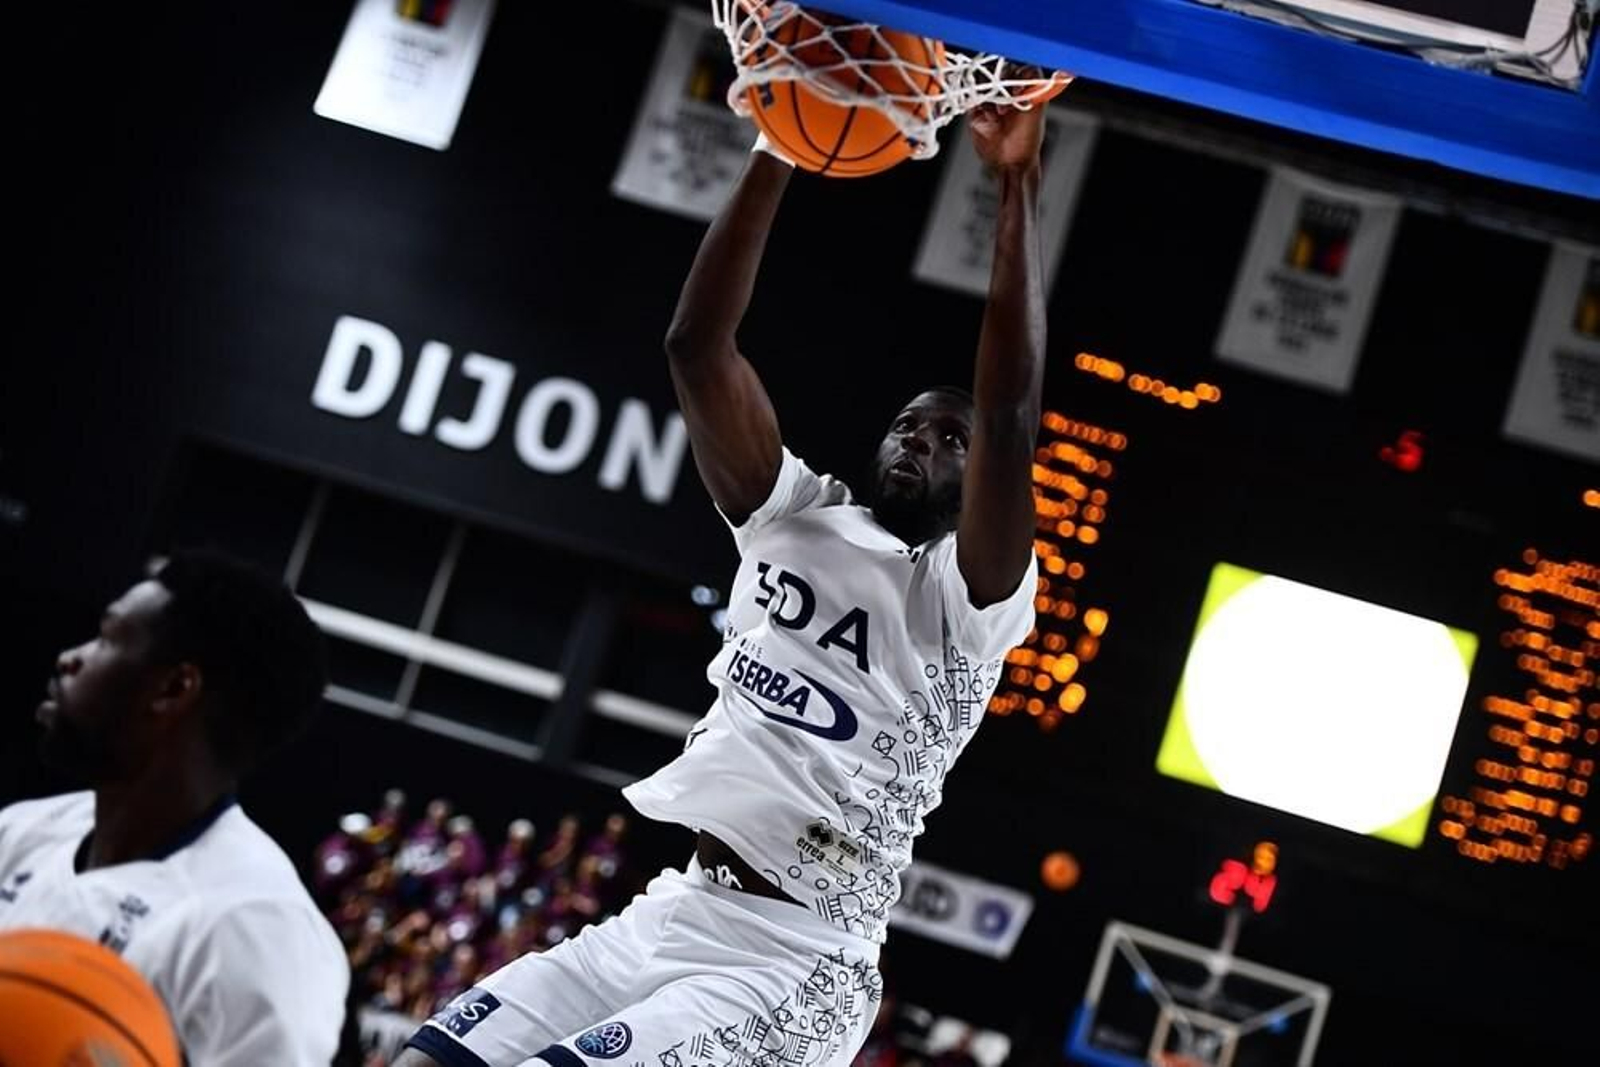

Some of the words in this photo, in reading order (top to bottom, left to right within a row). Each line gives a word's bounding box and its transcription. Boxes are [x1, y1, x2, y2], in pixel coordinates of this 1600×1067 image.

[311, 314, 690, 502] DIJON
[726, 650, 811, 717] ISERBA
[1209, 859, 1277, 914] 24
